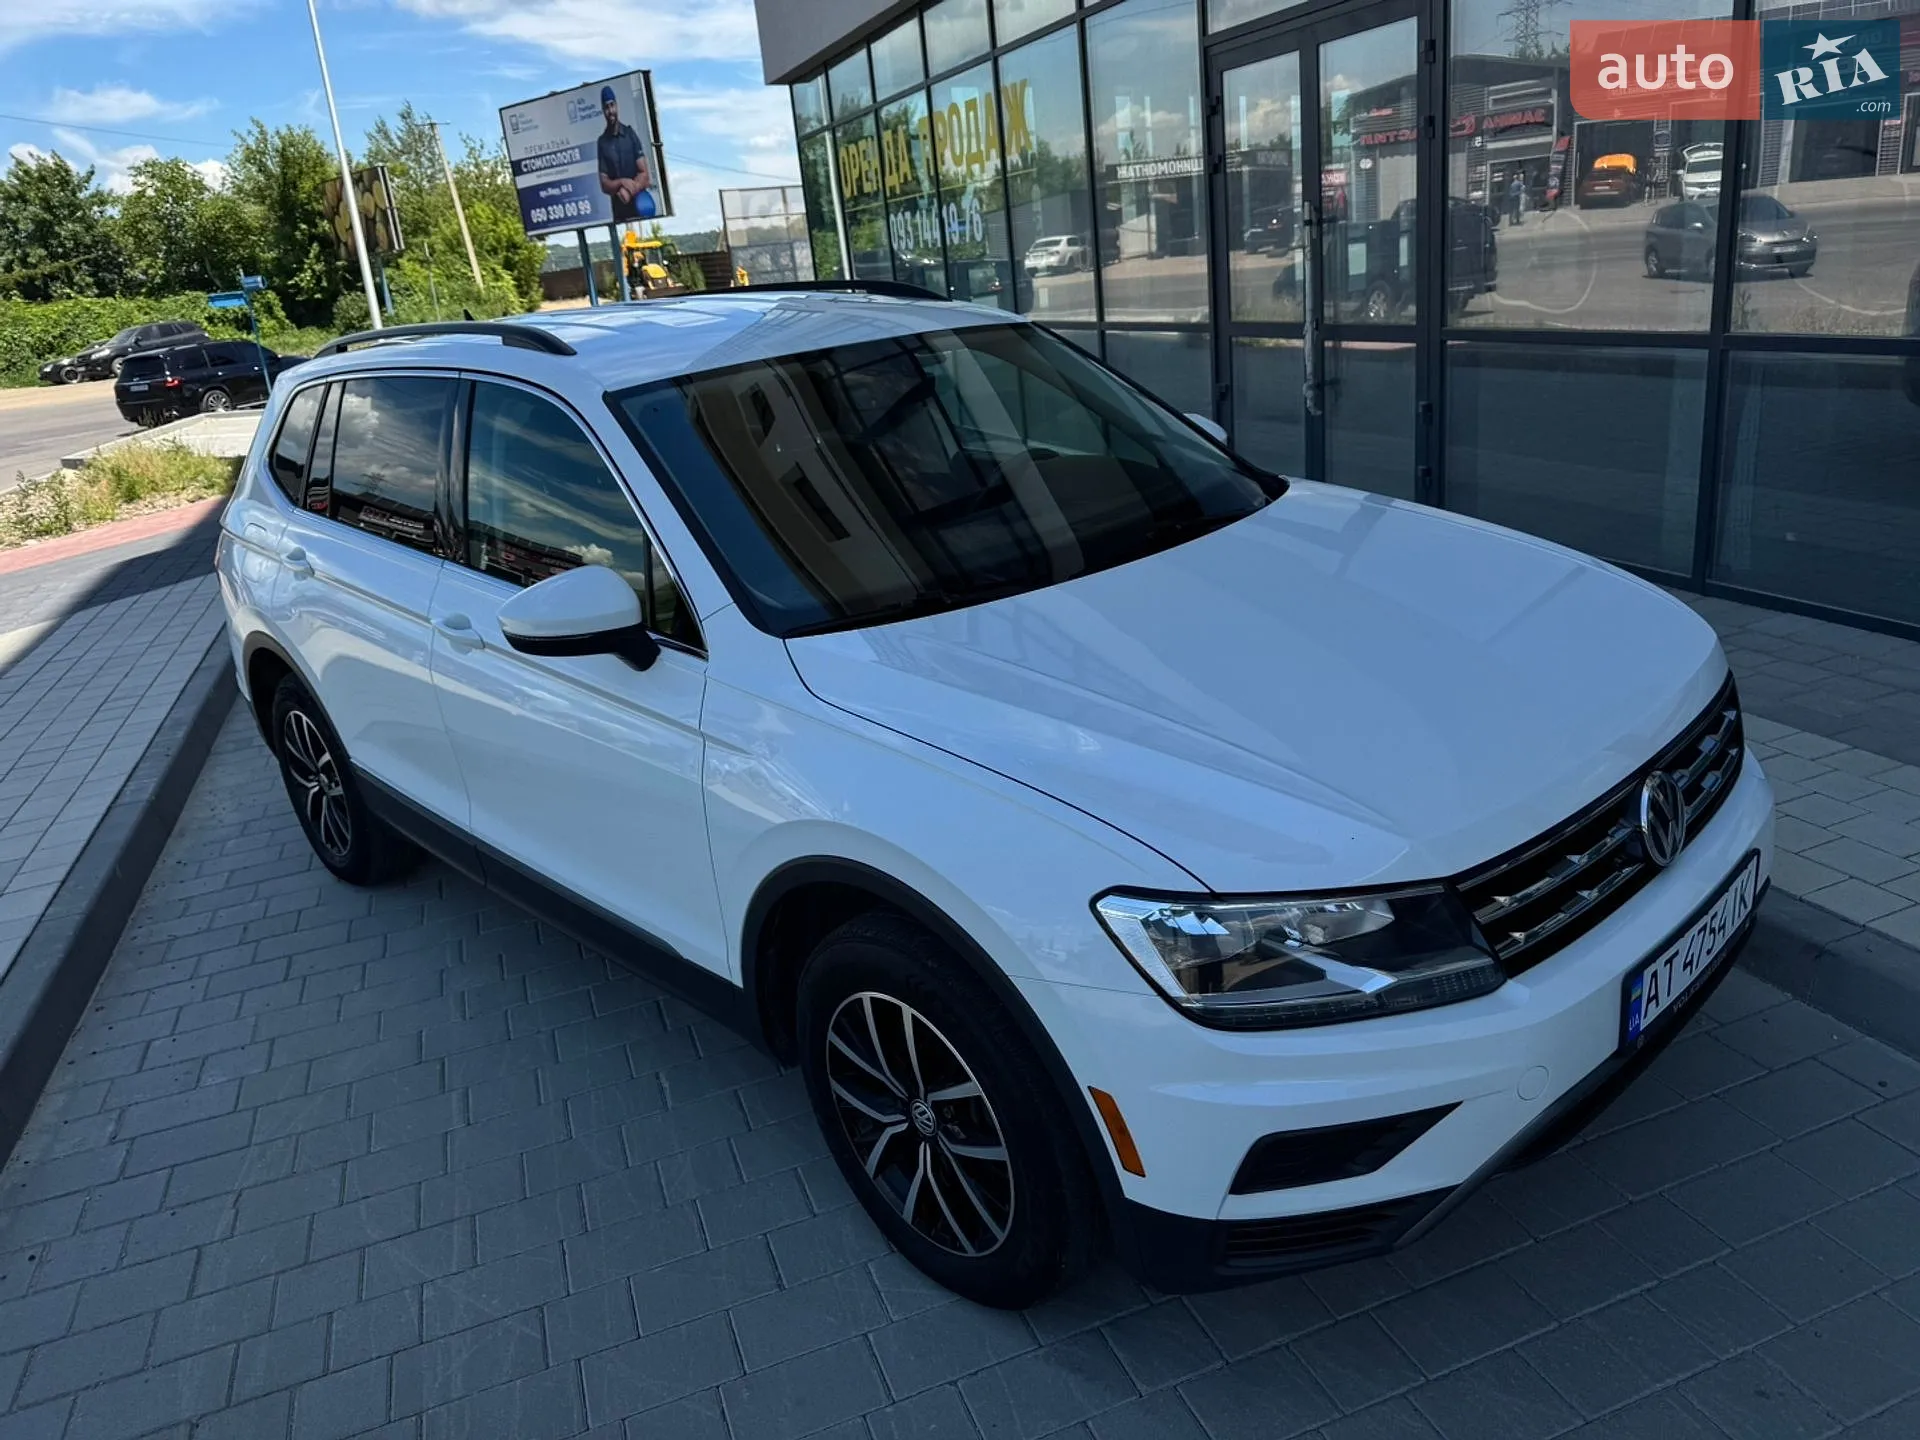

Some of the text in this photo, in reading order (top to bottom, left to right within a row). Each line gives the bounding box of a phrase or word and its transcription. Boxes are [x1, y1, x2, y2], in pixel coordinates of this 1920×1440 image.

[839, 79, 1033, 199] ОРЕНДА ПРОДАЖ
[530, 199, 592, 223] 050 330 00 99
[889, 211, 914, 251] 093
[1643, 950, 1679, 1020] AT
[1682, 899, 1728, 976] 4754
[1732, 869, 1752, 926] IK
[1628, 1013, 1640, 1031] UA
